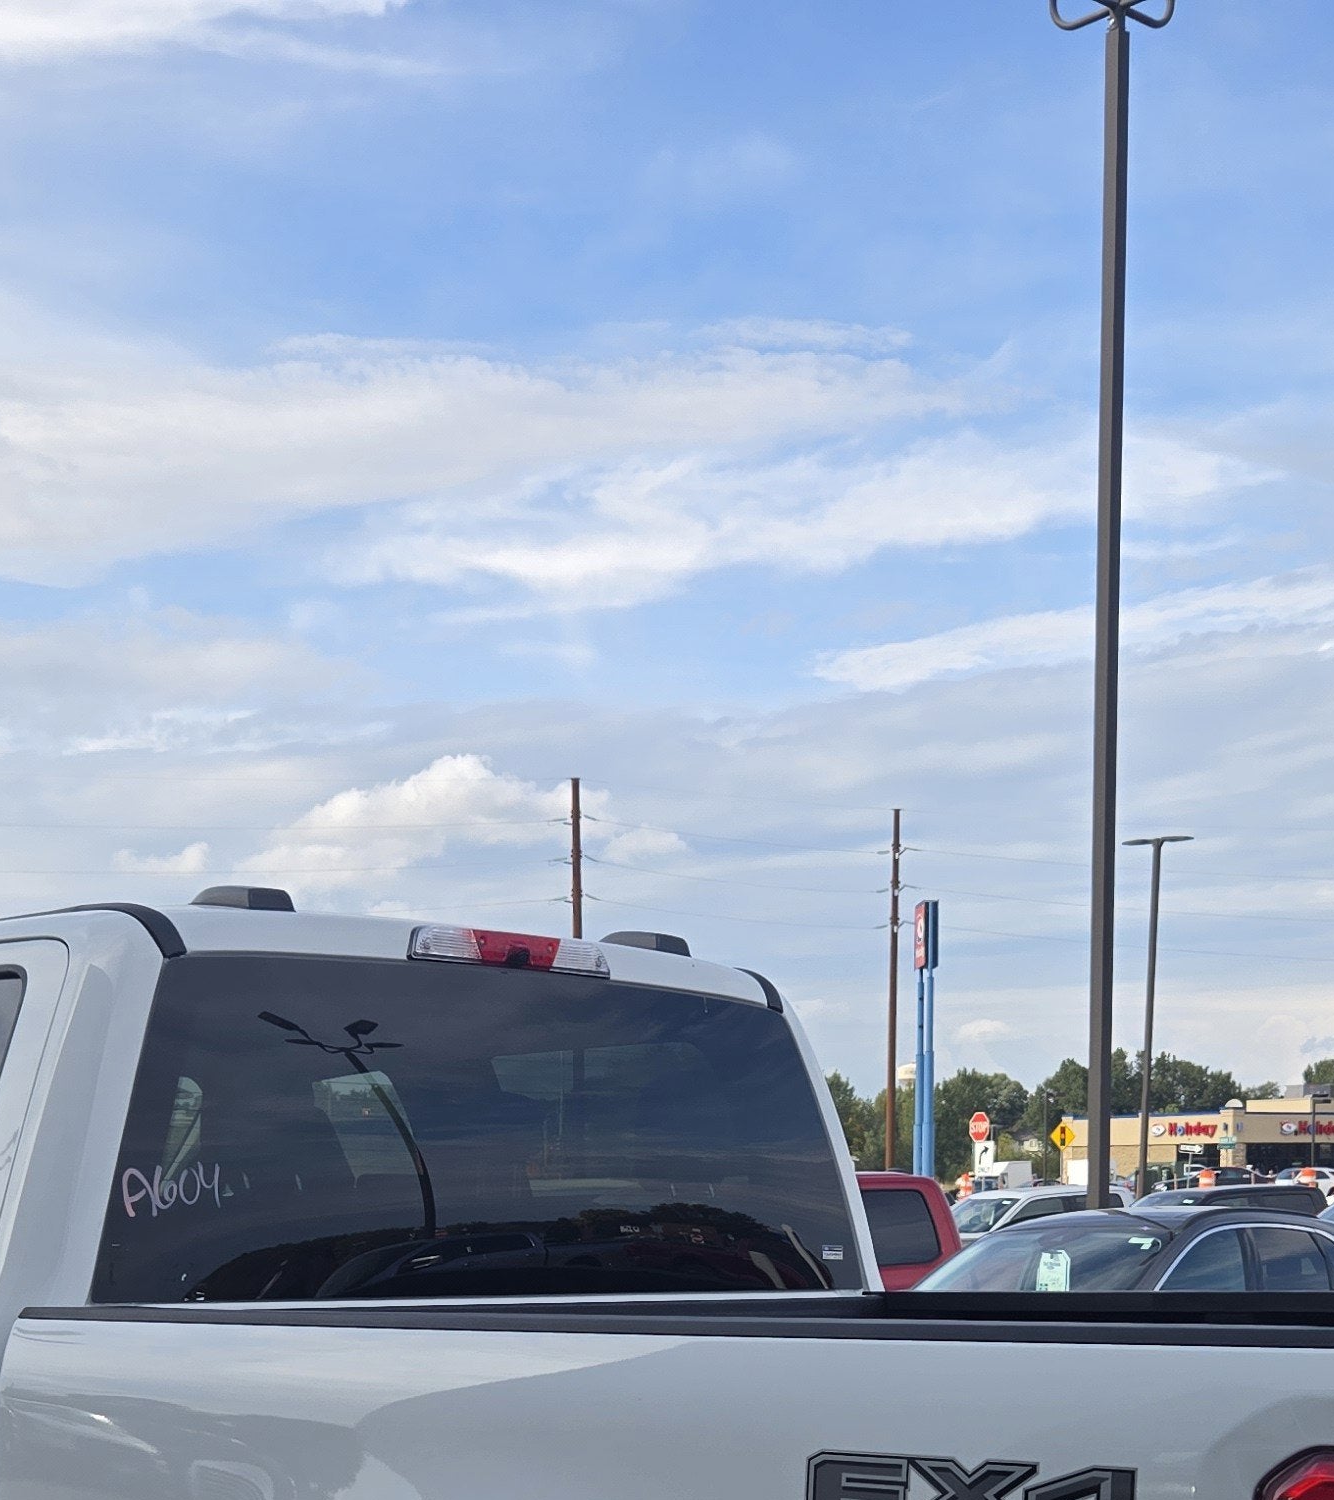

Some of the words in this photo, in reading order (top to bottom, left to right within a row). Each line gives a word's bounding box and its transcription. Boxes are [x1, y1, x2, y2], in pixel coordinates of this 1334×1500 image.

[970, 1121, 987, 1132] STOP
[1168, 1121, 1218, 1138] Holiday
[122, 1161, 221, 1217] A604
